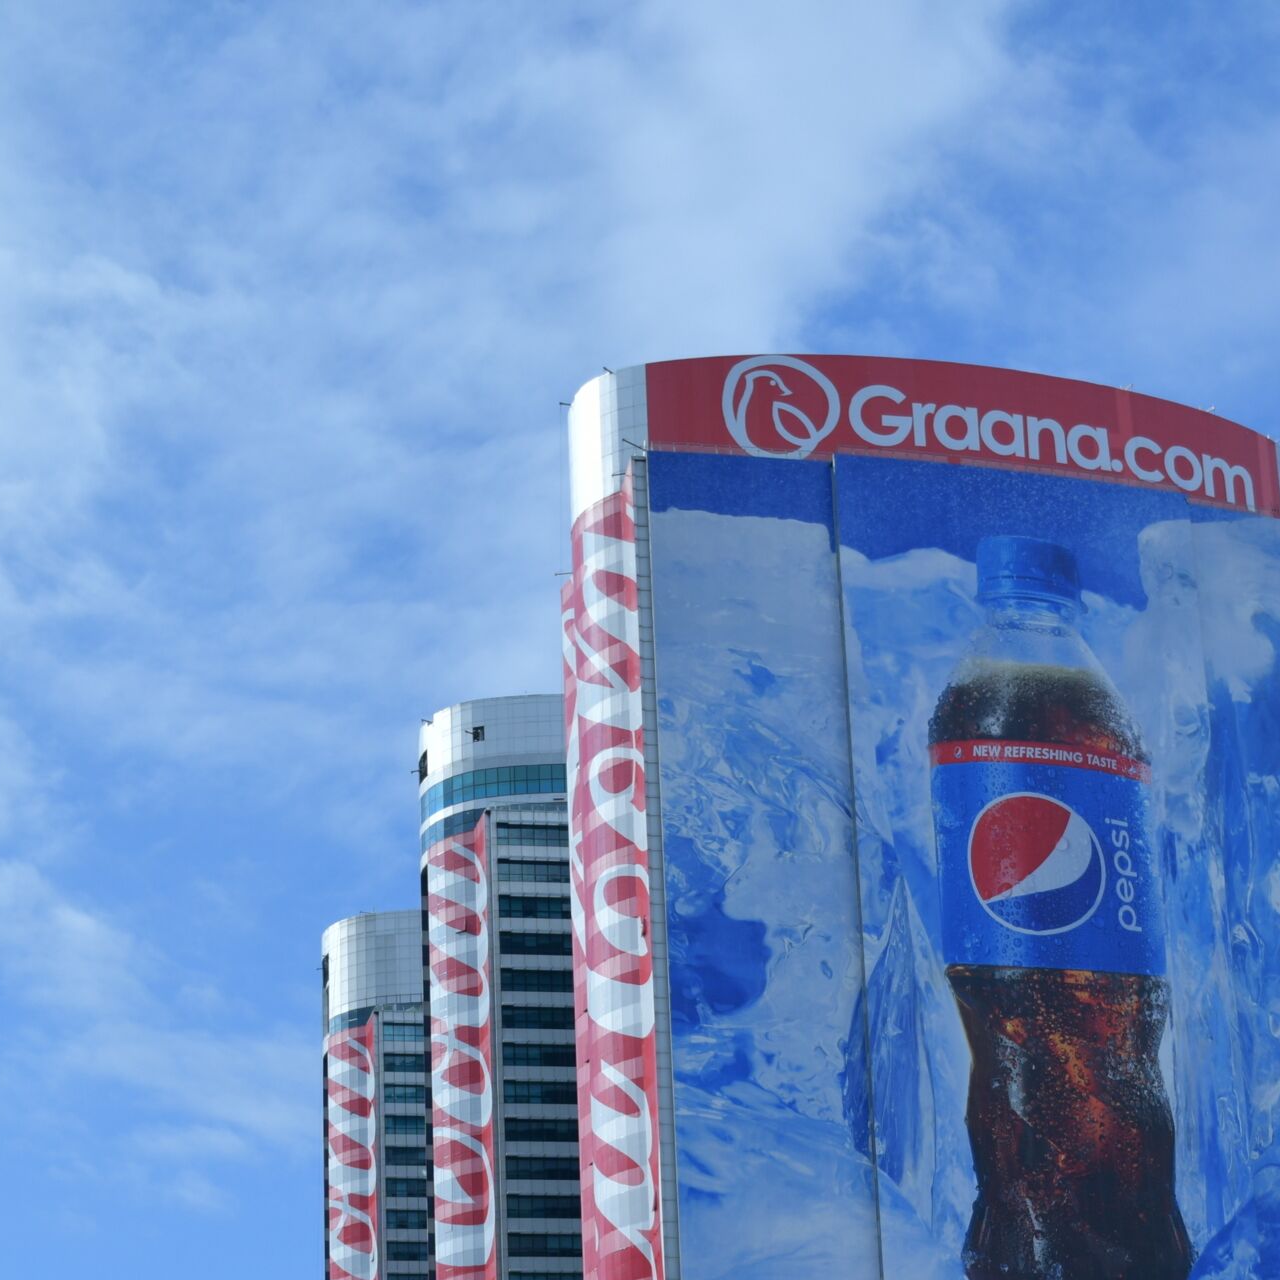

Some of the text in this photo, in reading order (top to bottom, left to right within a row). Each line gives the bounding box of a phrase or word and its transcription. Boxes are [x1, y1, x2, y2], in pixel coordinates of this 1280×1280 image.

[849, 384, 1256, 512] Graana.com
[972, 743, 1118, 771] NEW REFRESHING TASTE
[1104, 817, 1143, 933] pepsi
